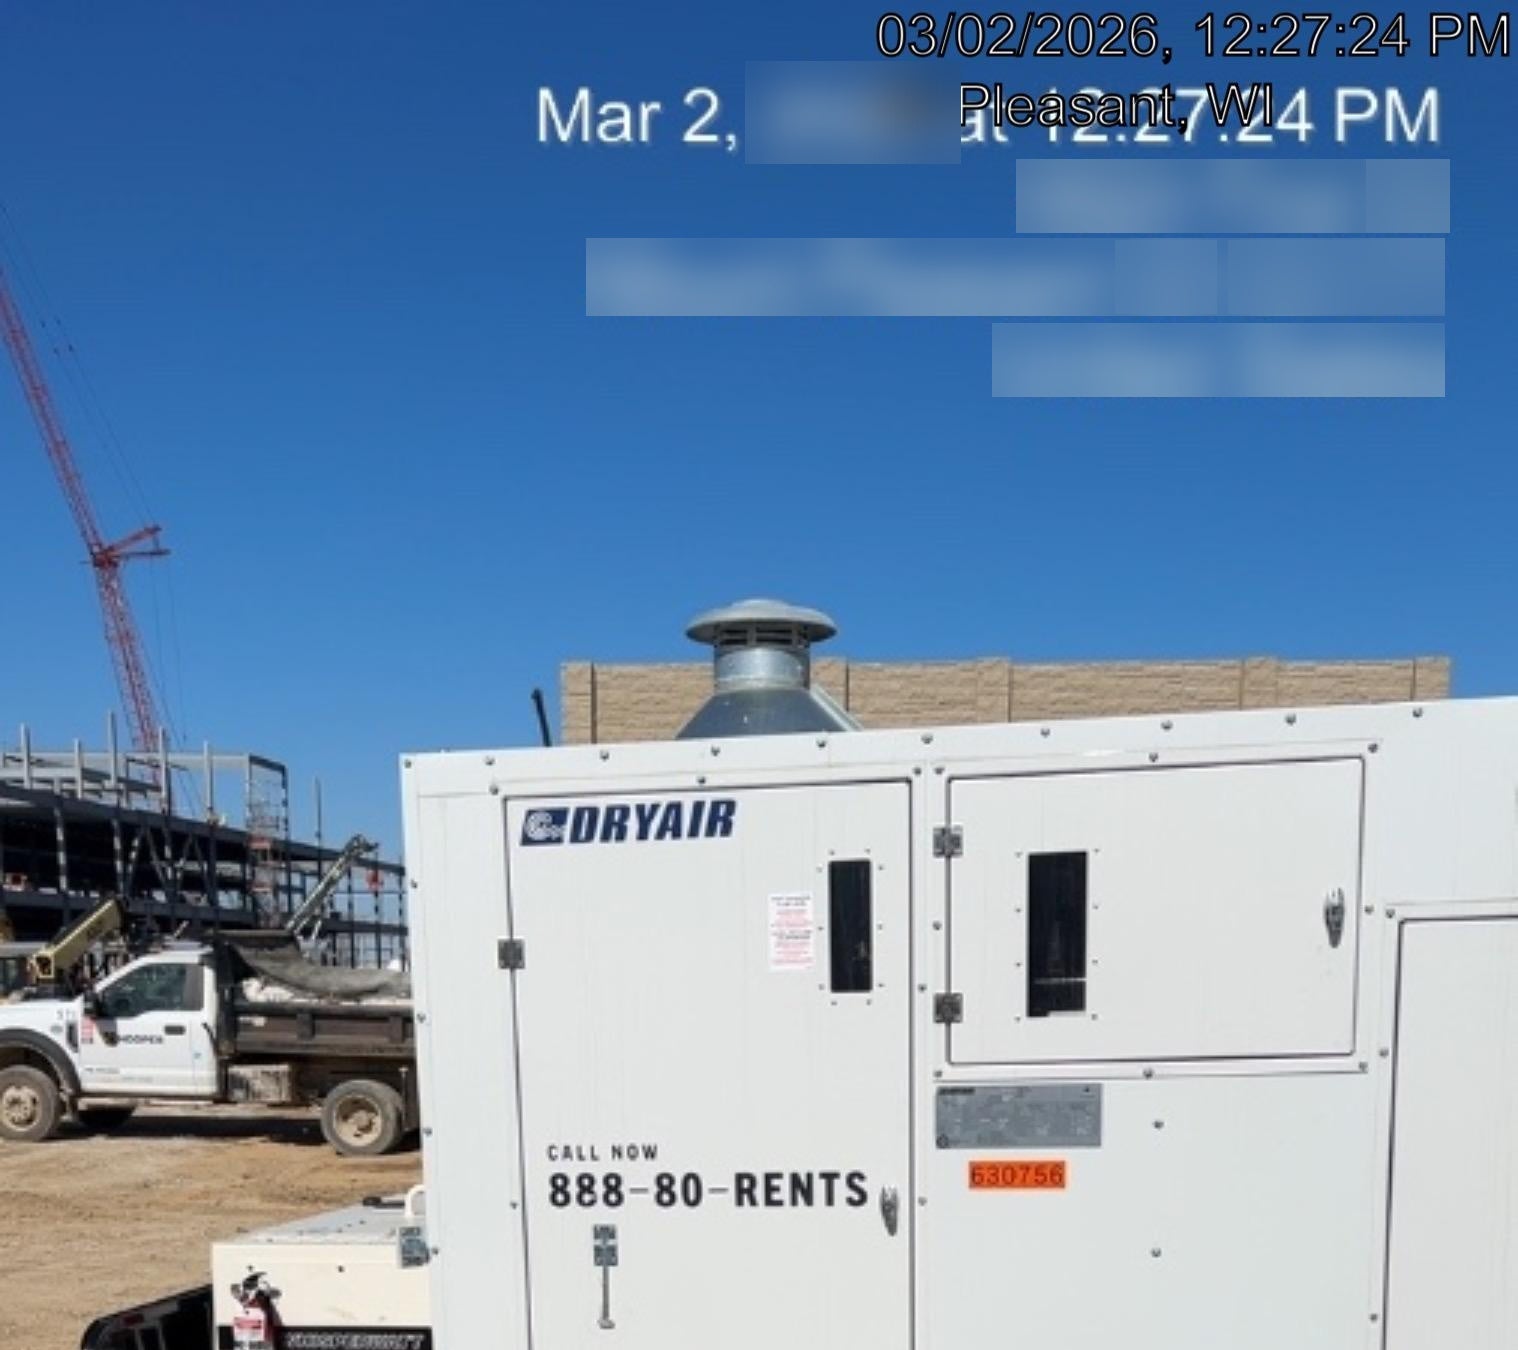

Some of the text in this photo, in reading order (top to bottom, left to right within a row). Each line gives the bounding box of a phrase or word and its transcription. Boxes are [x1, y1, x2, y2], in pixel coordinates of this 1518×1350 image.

[569, 799, 736, 844] DRYAIR
[547, 1144, 658, 1162] CALL NOW
[549, 1171, 868, 1208] 888-80-RENTS
[971, 1164, 1063, 1186] 630756
